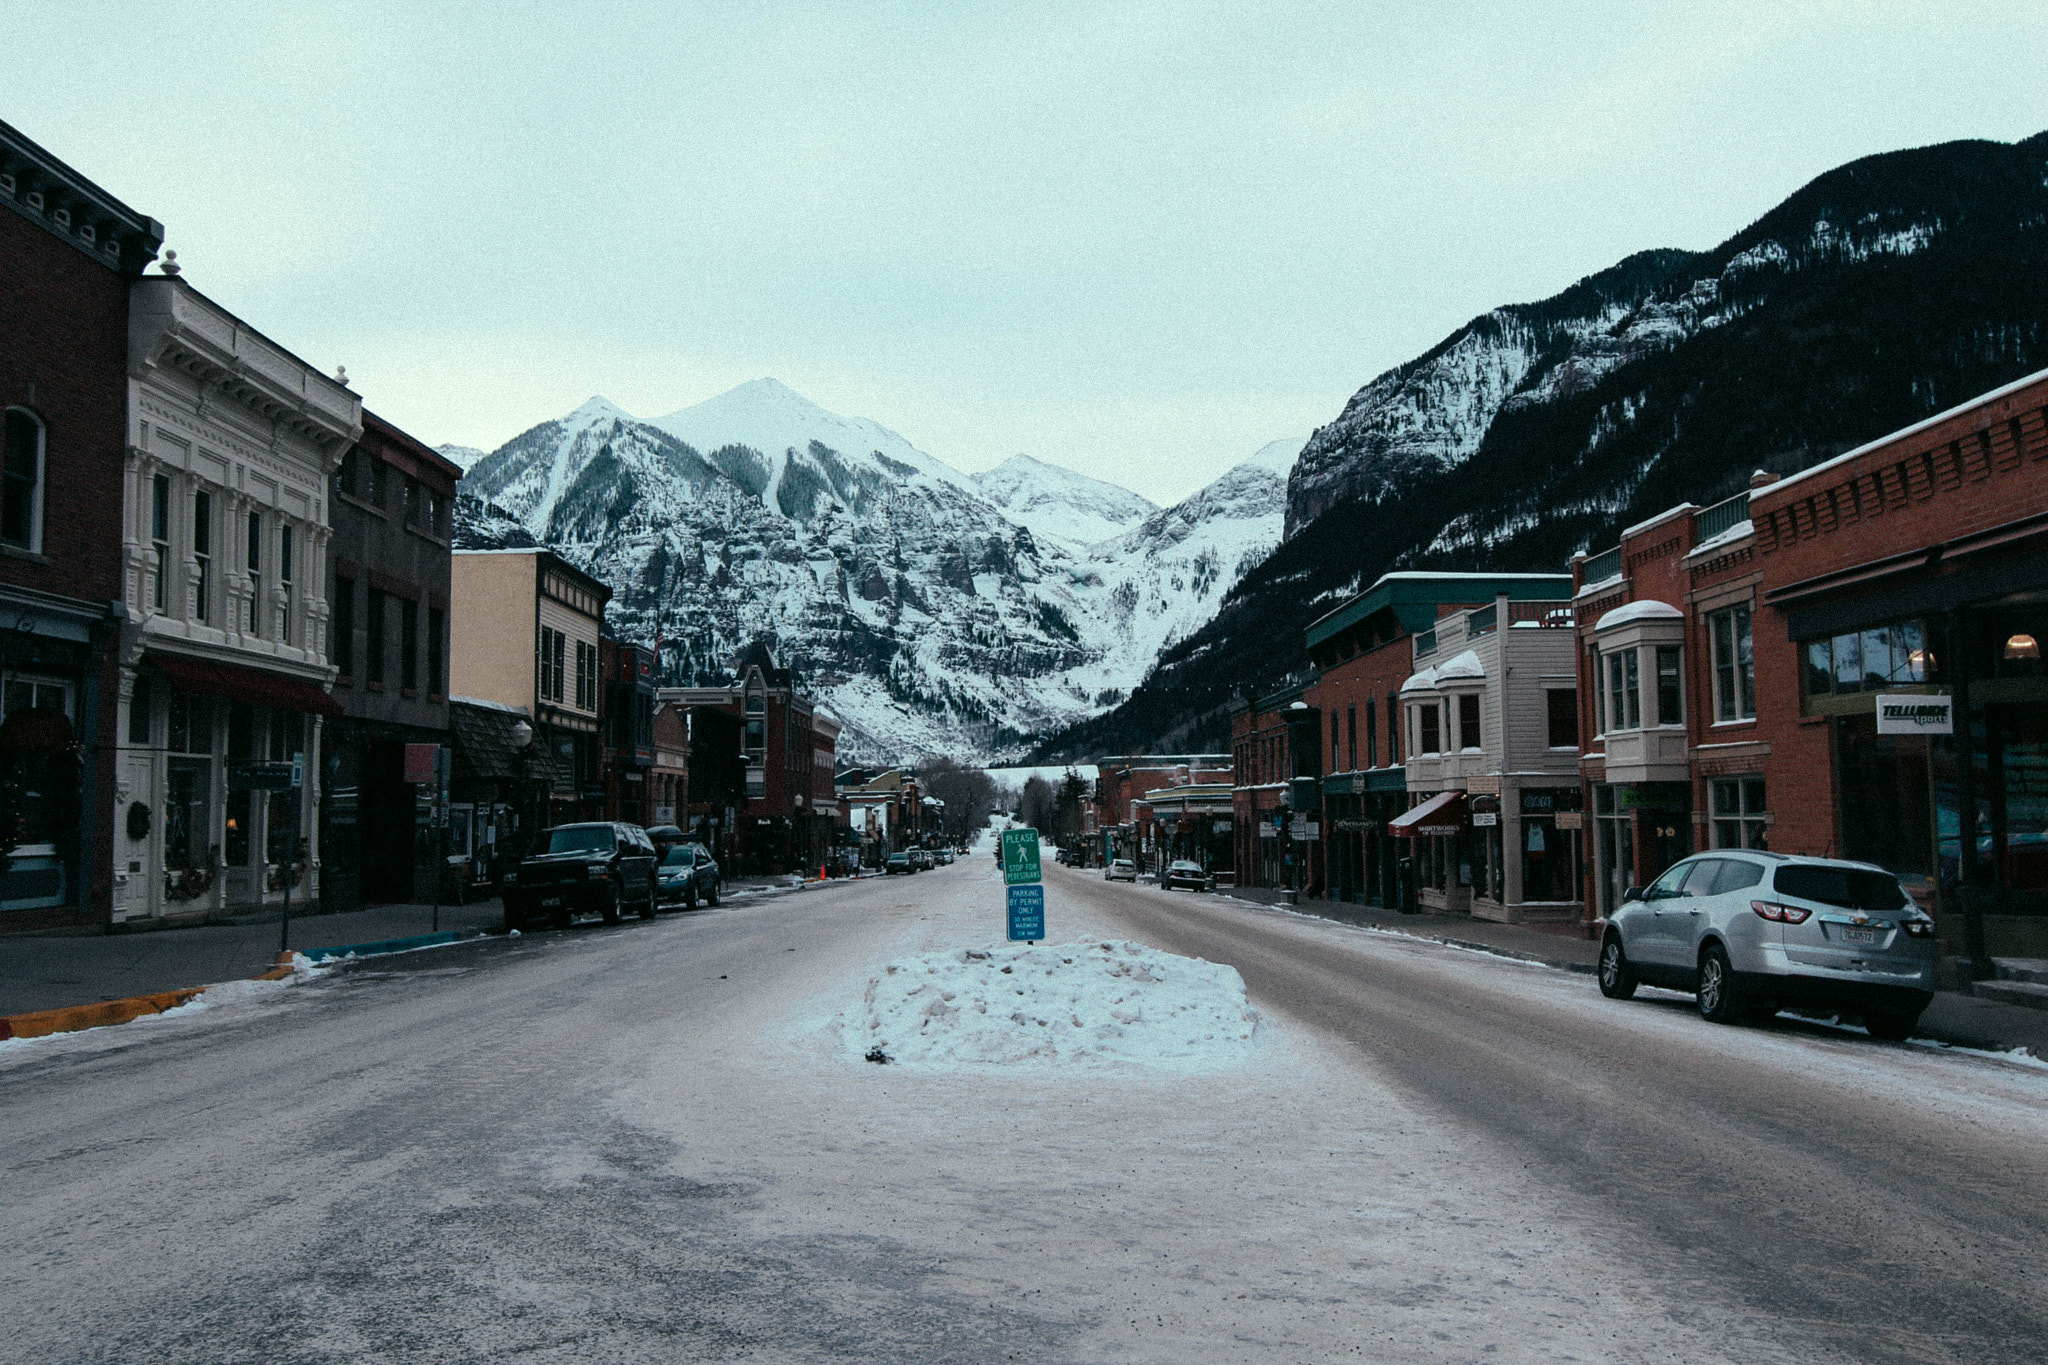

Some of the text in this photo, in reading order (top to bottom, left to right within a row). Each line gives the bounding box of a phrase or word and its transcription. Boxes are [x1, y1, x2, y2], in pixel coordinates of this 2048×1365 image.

[1883, 705, 1949, 716] TELLURIDE
[1914, 715, 1949, 727] sports
[1006, 833, 1035, 844] PLEASE
[1009, 863, 1038, 872] STOP FOR
[1007, 871, 1040, 881] PEDESTRIANS
[1012, 889, 1039, 897] PARKING
[1009, 898, 1042, 906] BY PERMIT
[1018, 906, 1034, 914] ONLY
